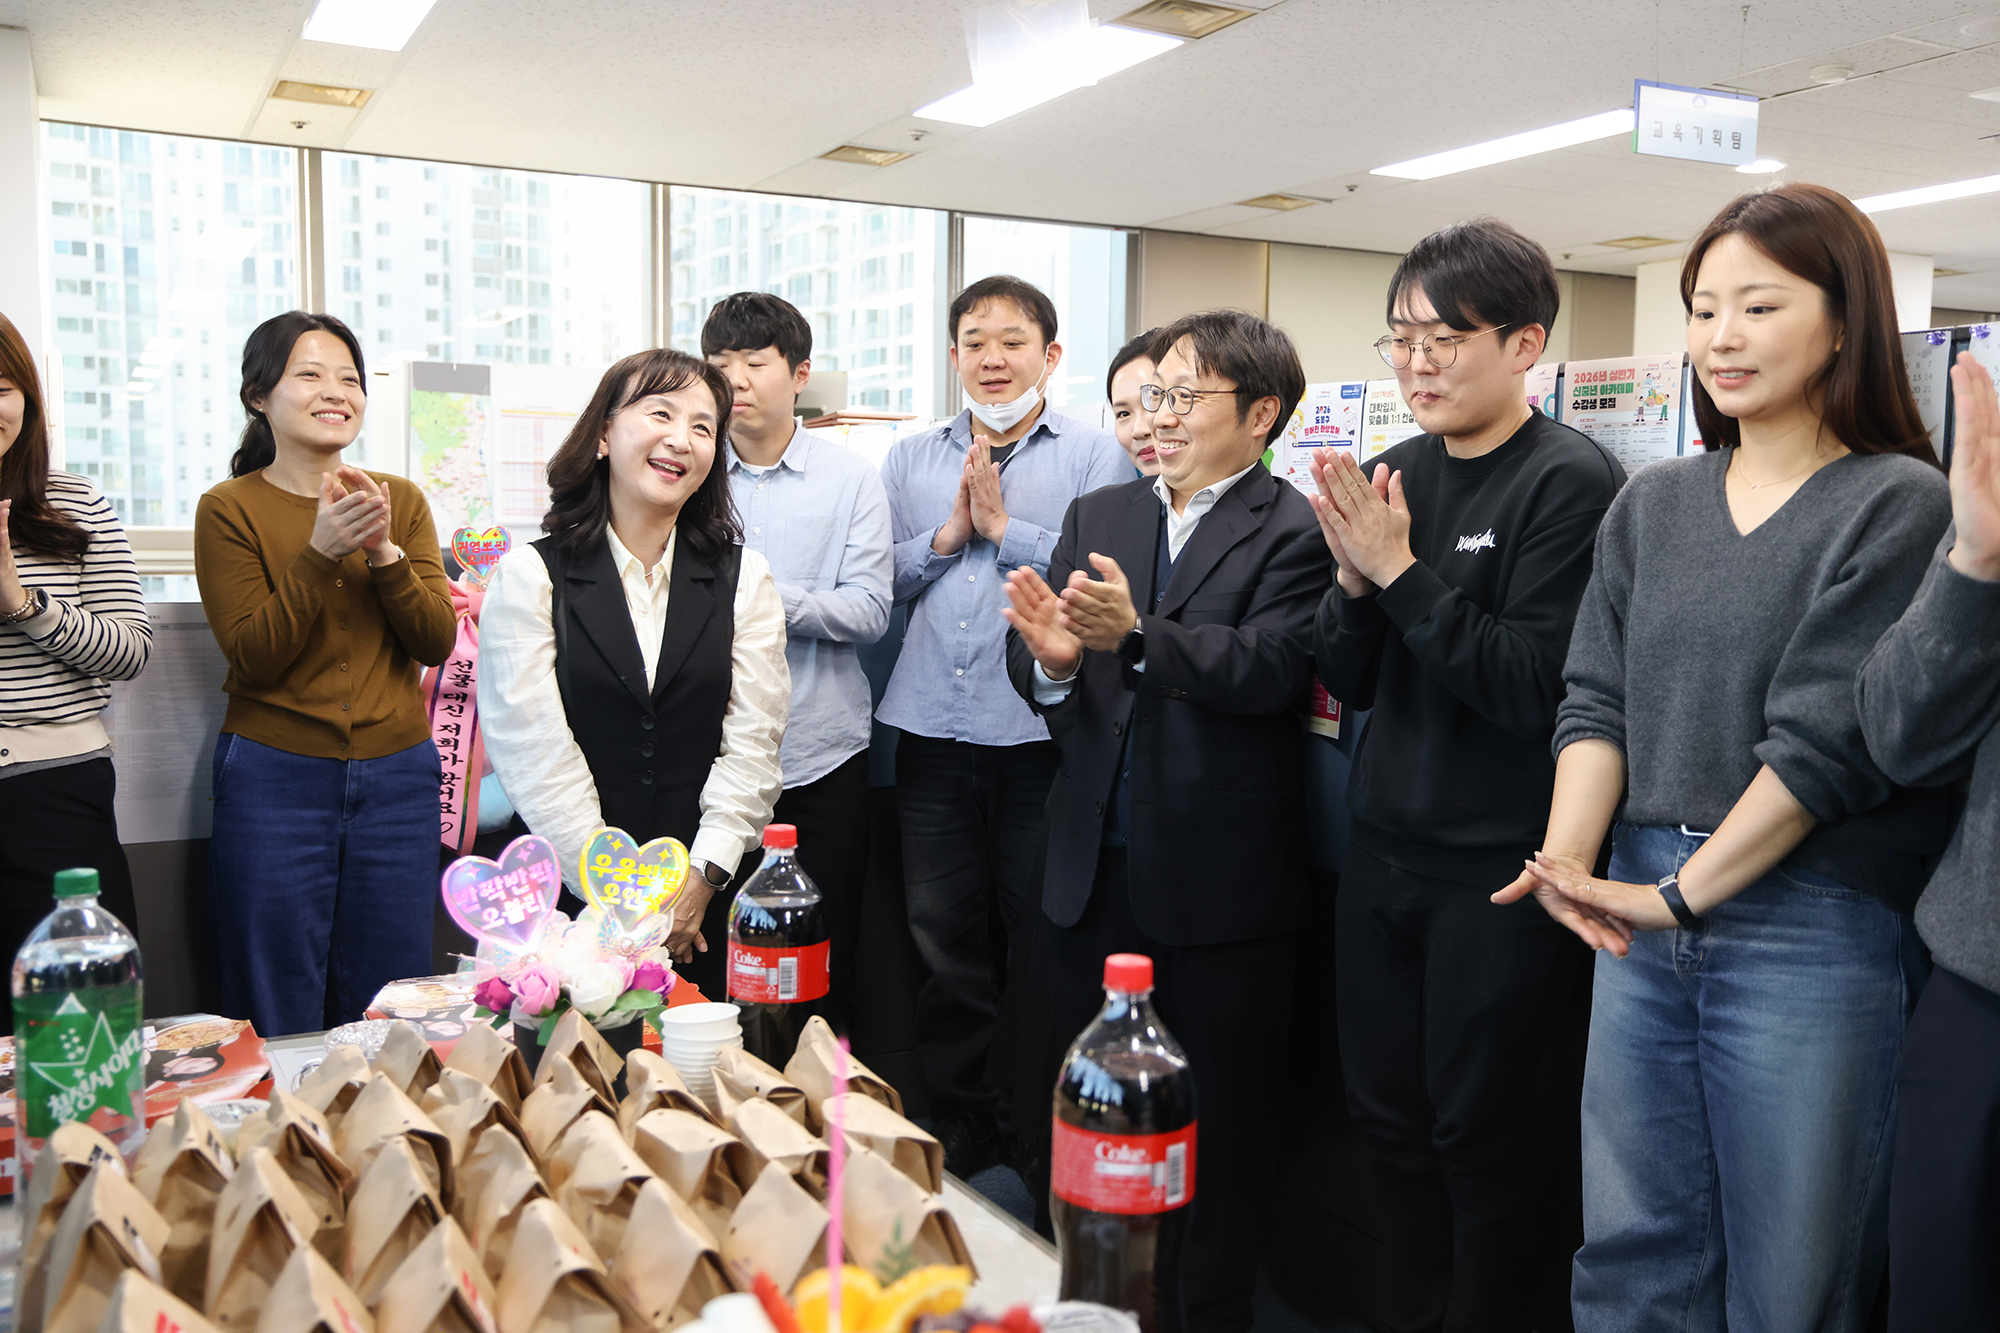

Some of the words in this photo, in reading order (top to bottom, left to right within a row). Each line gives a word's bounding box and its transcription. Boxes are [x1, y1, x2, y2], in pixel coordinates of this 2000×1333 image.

[1653, 120, 1742, 150] 교육기획팀
[1915, 361, 1921, 369] 6
[1574, 371, 1607, 384] 2026년
[1609, 368, 1636, 381] 상반기
[1913, 373, 1921, 381] 13
[1573, 384, 1598, 397] 신중년
[1600, 382, 1634, 395] 아카데미
[1369, 402, 1397, 413] 대학입시
[1572, 398, 1598, 411] 수강생
[1599, 397, 1617, 409] 모집
[1315, 415, 1330, 424] 도봉구
[1368, 414, 1389, 426] 맞춤형
[1391, 414, 1400, 424] 1:1
[1402, 413, 1418, 424] 컨설
[457, 540, 507, 554] 귀염뽀짝
[447, 659, 476, 689] 선물
[438, 691, 468, 718] 대신
[589, 853, 682, 893] 우윳빛깔
[452, 858, 556, 914] 반짝반짝
[480, 889, 548, 932] 오블리
[734, 949, 763, 967] Coke
[1094, 1140, 1147, 1162] Coke
